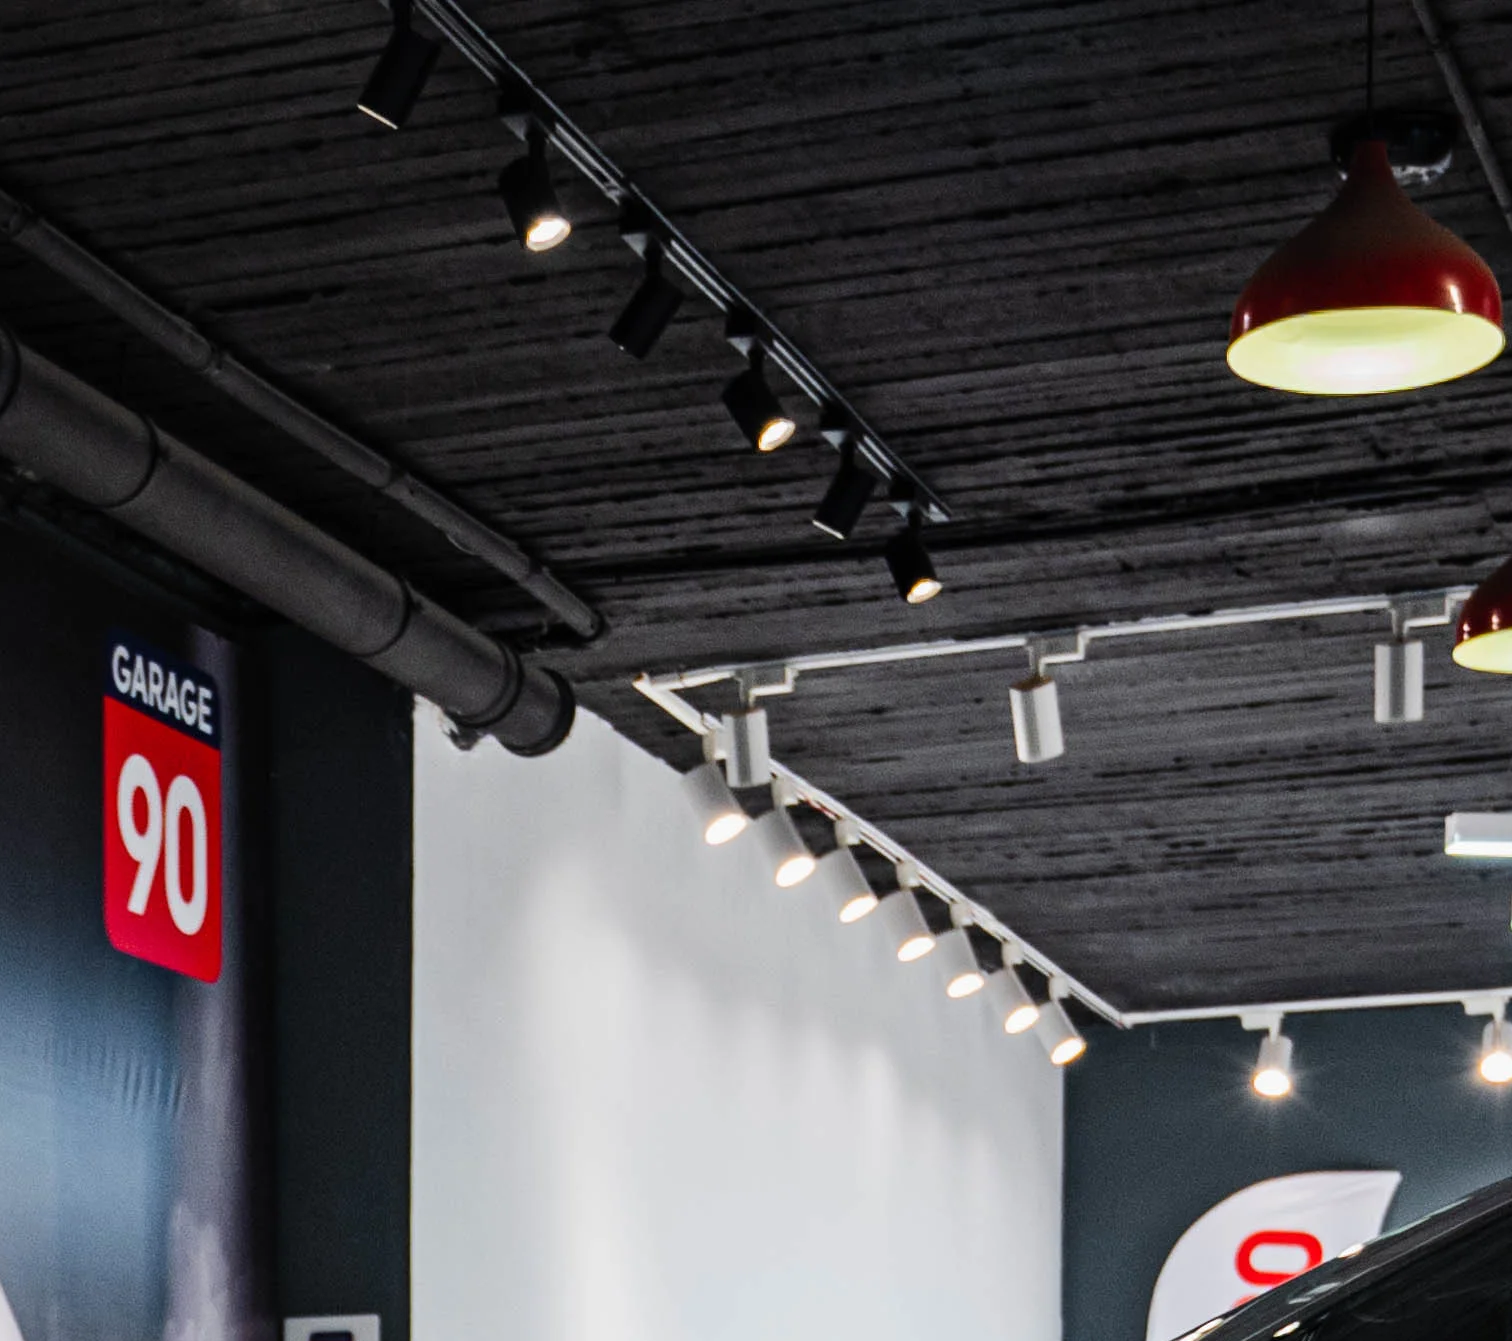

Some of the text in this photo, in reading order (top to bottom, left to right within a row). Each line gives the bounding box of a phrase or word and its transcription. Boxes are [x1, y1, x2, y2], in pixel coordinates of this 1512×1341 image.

[111, 644, 214, 735] GARAGE
[116, 752, 208, 936] 90
[1233, 1228, 1323, 1309] 0
